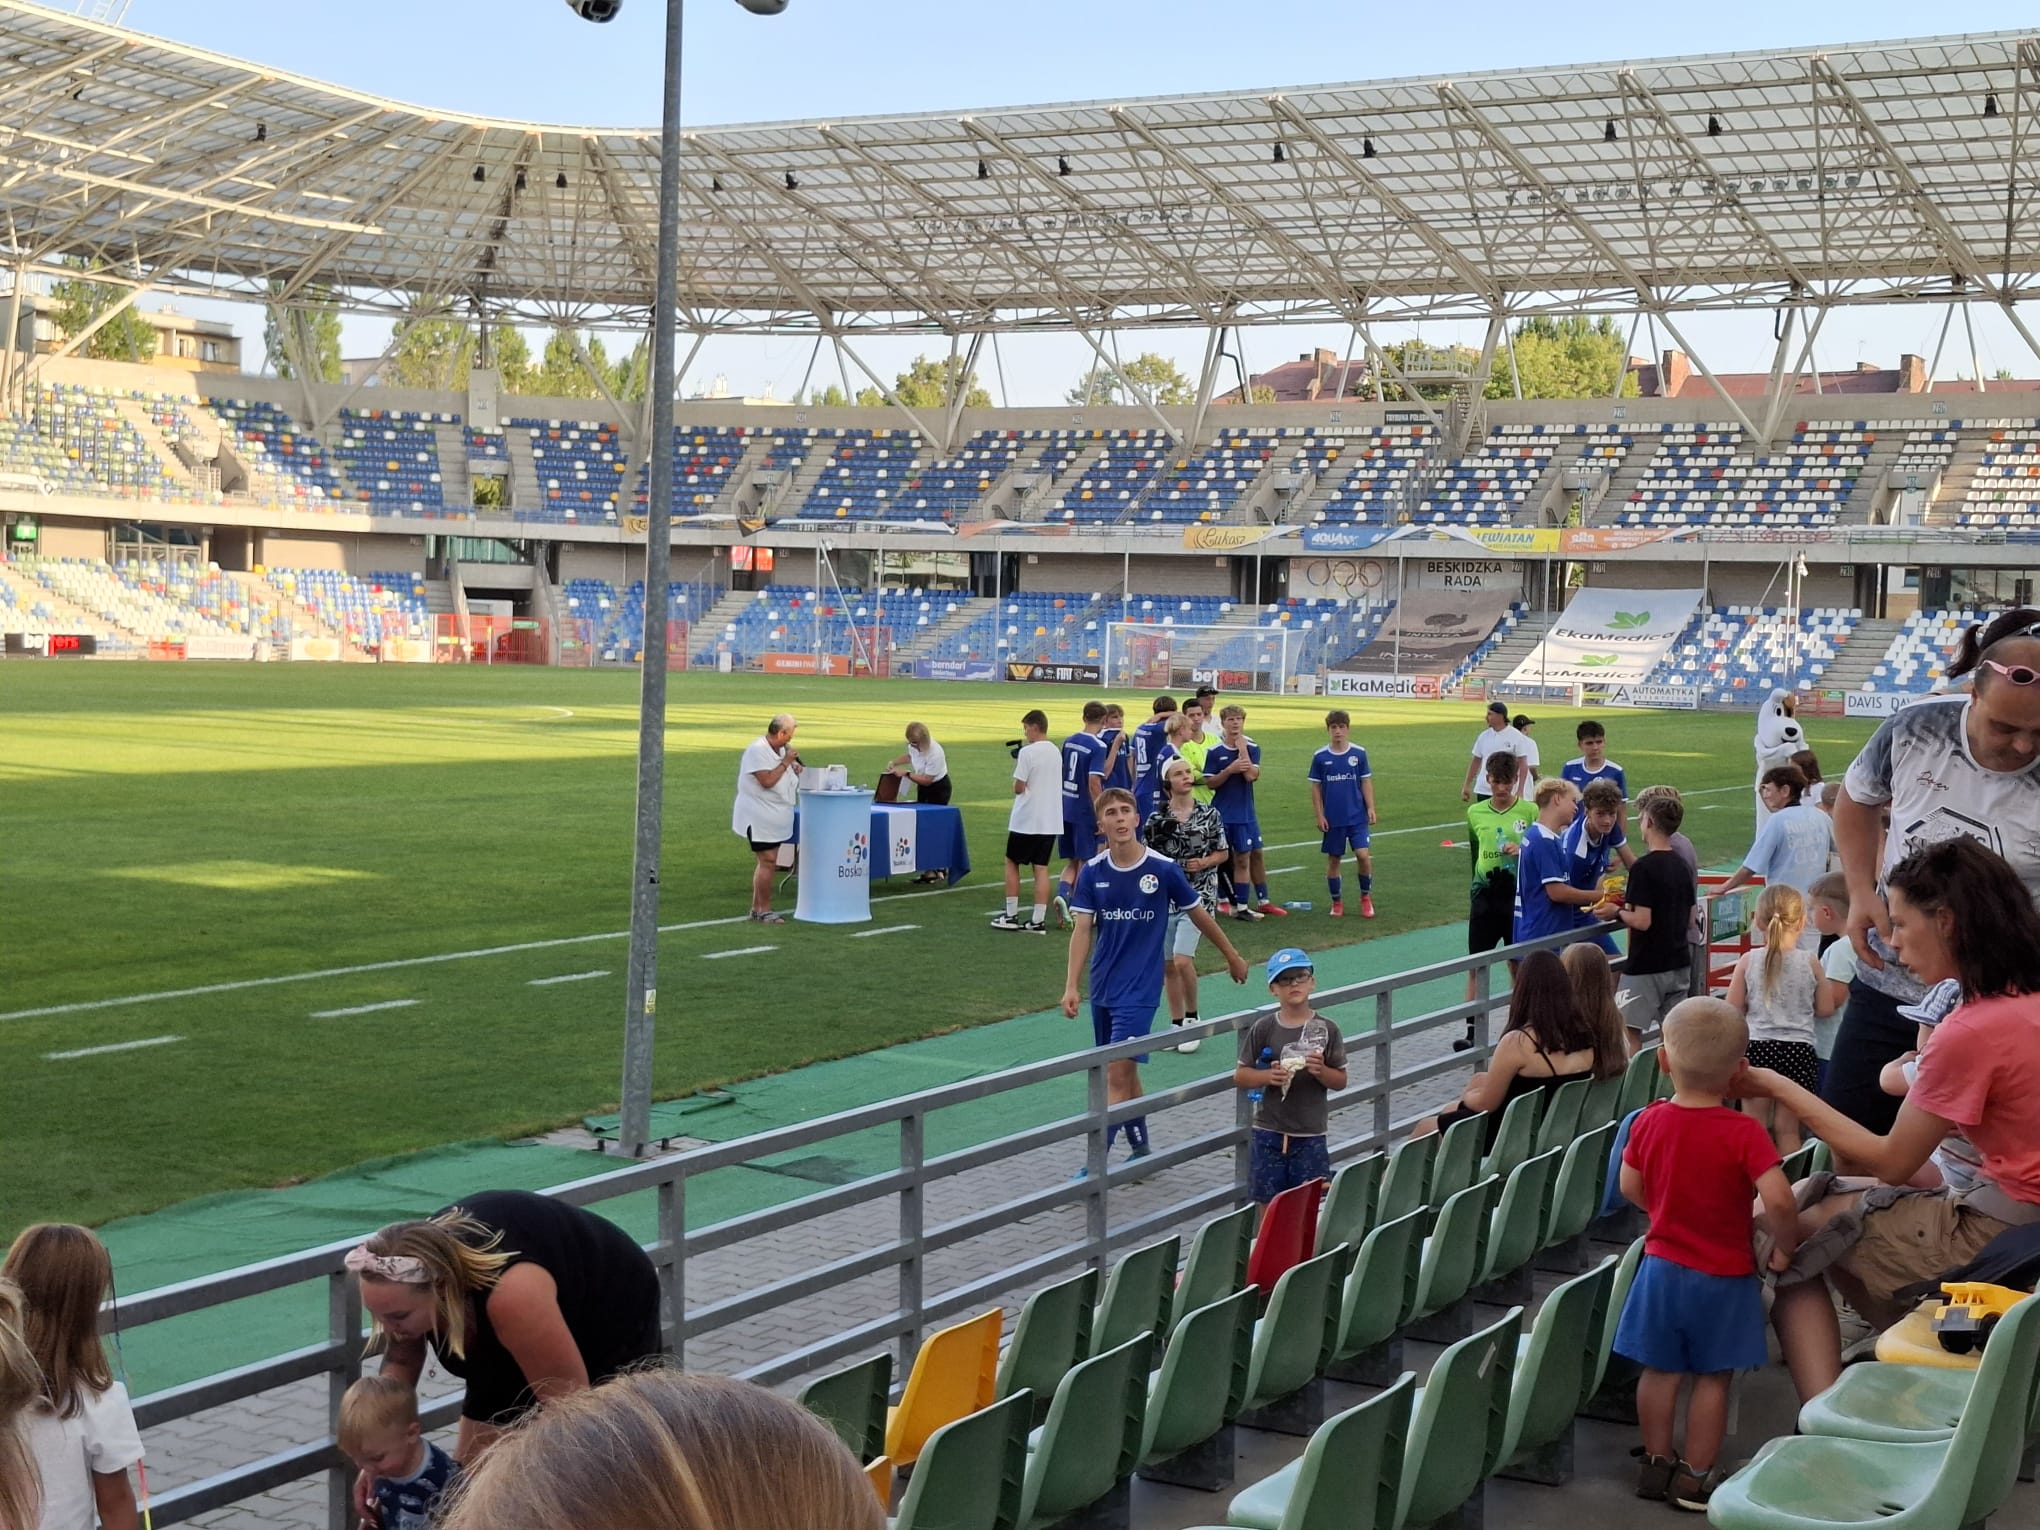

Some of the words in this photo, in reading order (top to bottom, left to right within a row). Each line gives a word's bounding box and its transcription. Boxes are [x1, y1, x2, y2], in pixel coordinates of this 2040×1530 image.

[1427, 561, 1503, 573] BESKIDZKA
[1444, 575, 1482, 587] RADA
[1555, 627, 1676, 642] EkaMedica
[1056, 667, 1073, 680] FIAT
[1521, 668, 1645, 679] EkaMedica
[1341, 678, 1431, 694] EkaMedica
[1632, 686, 1695, 697] AUTOMATYKA
[1847, 696, 1883, 709] DAVIS
[1068, 751, 1079, 781] 9
